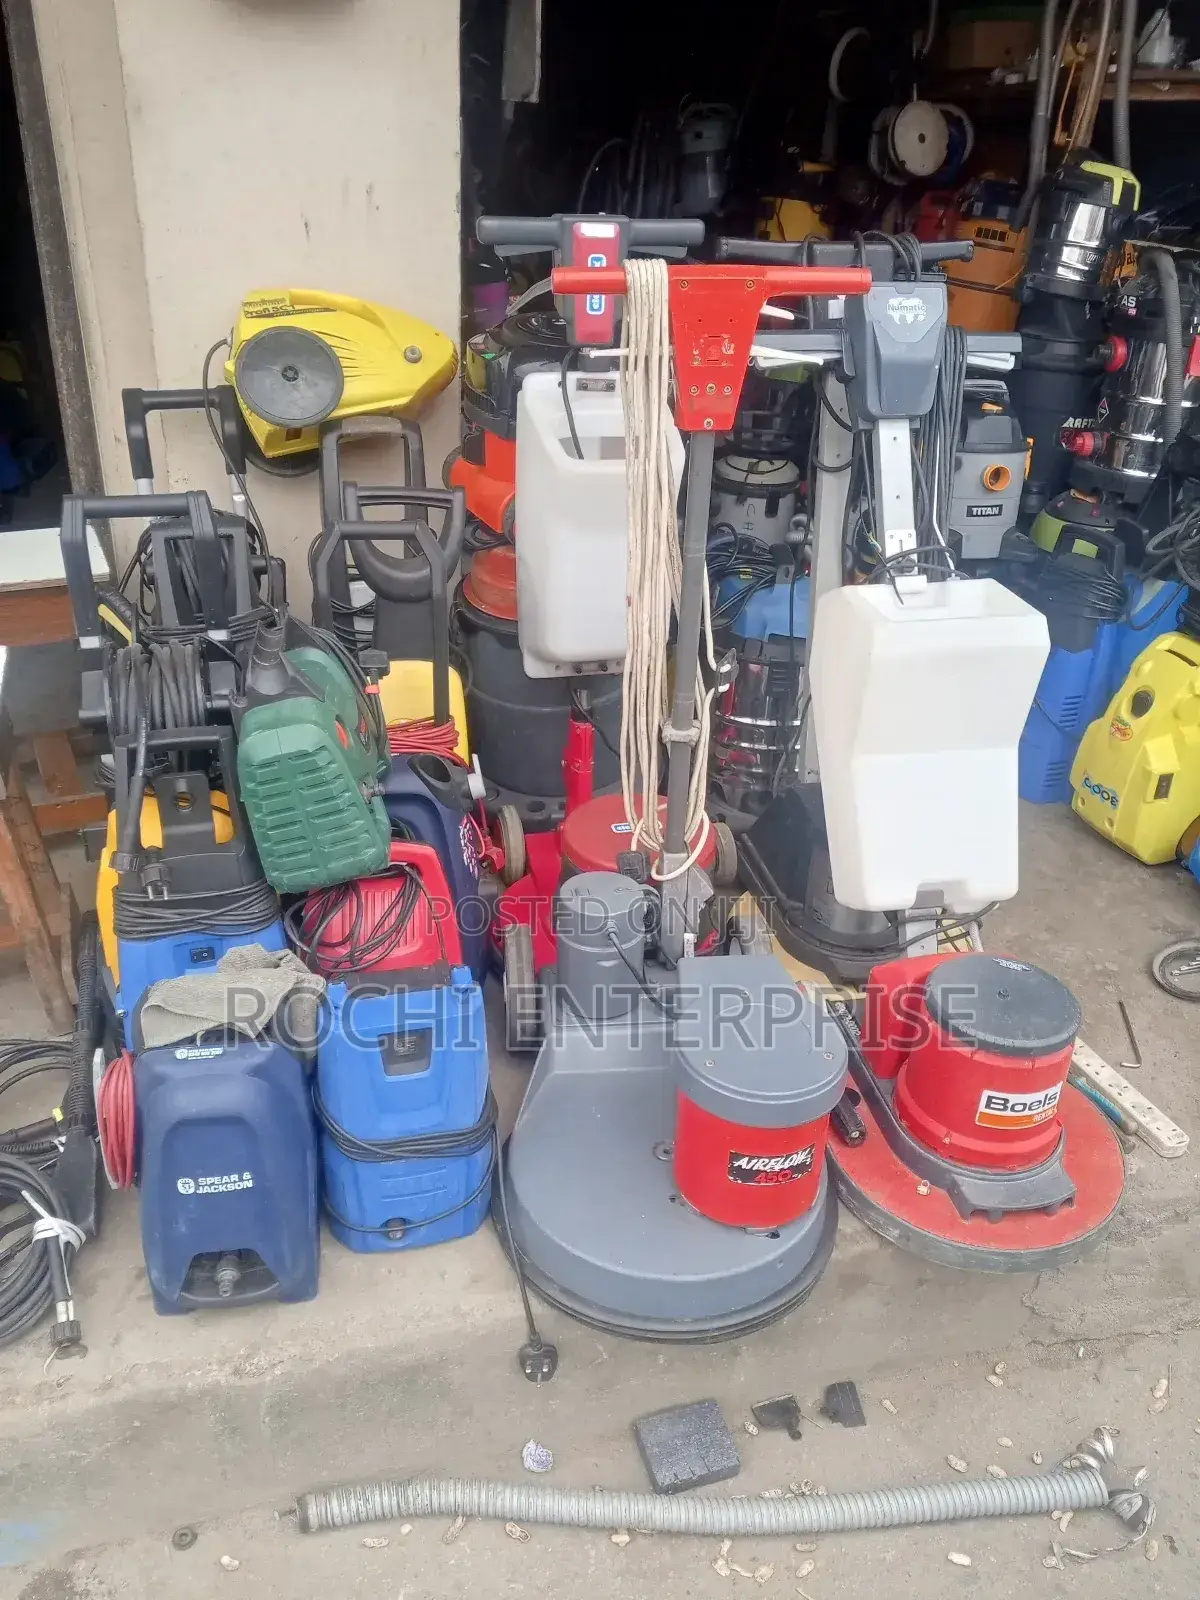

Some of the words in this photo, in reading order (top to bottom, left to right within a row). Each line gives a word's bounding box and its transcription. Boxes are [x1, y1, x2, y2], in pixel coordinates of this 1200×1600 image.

[887, 303, 927, 313] Numatic
[971, 506, 1000, 516] TITAN
[984, 1091, 1058, 1113] Boels
[733, 1147, 811, 1172] AIRFLOW
[198, 1174, 239, 1185] SPEAR
[242, 1171, 253, 1181] &
[755, 1169, 794, 1184] 450
[196, 1180, 253, 1194] JACKSON
